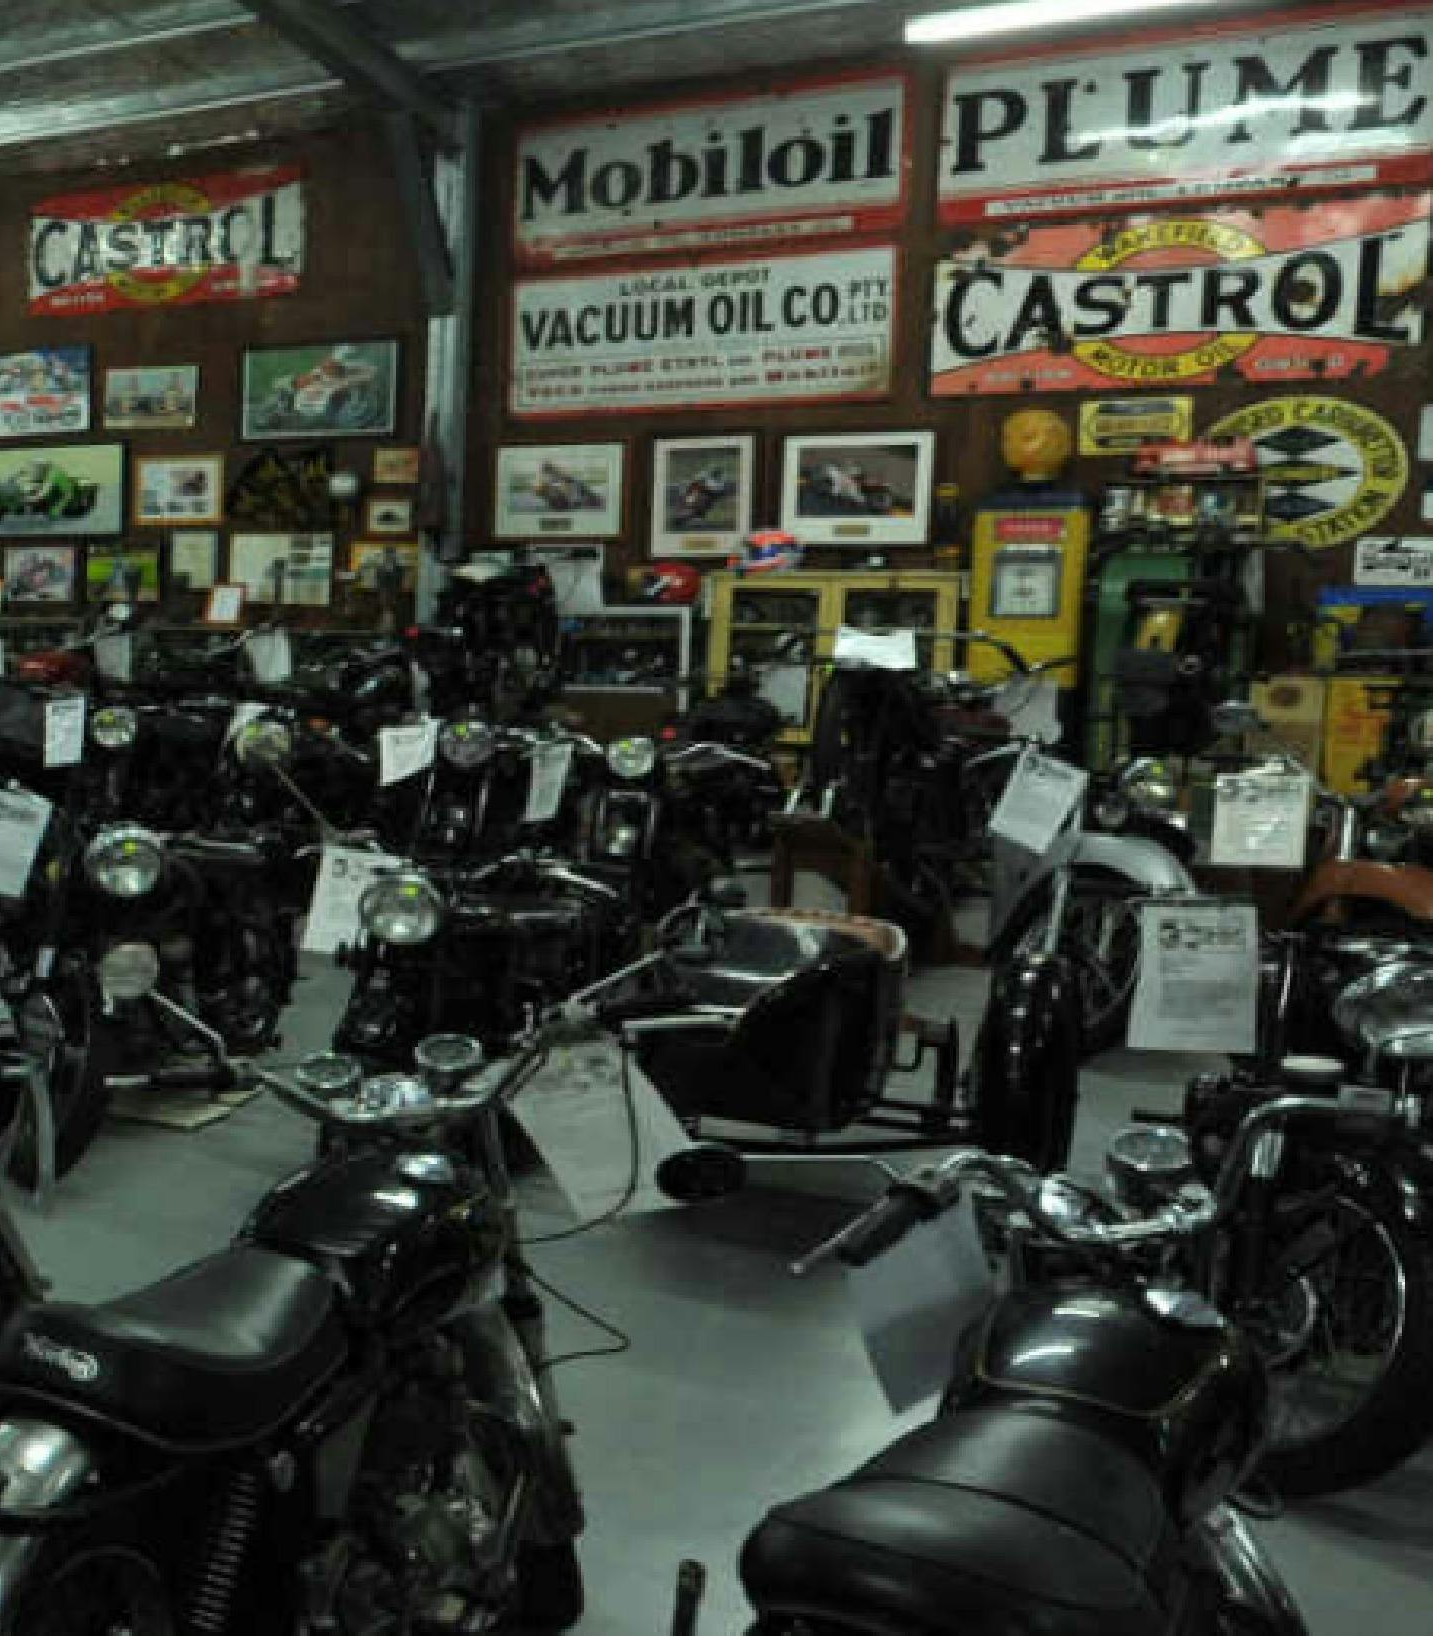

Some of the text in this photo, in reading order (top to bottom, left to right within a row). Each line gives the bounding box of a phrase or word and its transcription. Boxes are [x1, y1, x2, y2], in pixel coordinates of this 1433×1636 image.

[951, 36, 1429, 175] PLUME
[520, 108, 893, 221] Mobiloil
[35, 195, 295, 288] CASTROL
[619, 267, 772, 297] LOCAL DEPOT
[521, 296, 695, 350] VACUUM
[708, 291, 775, 335] OIL
[944, 233, 1410, 358] CASTROL
[1092, 348, 1181, 376] MOTOR
